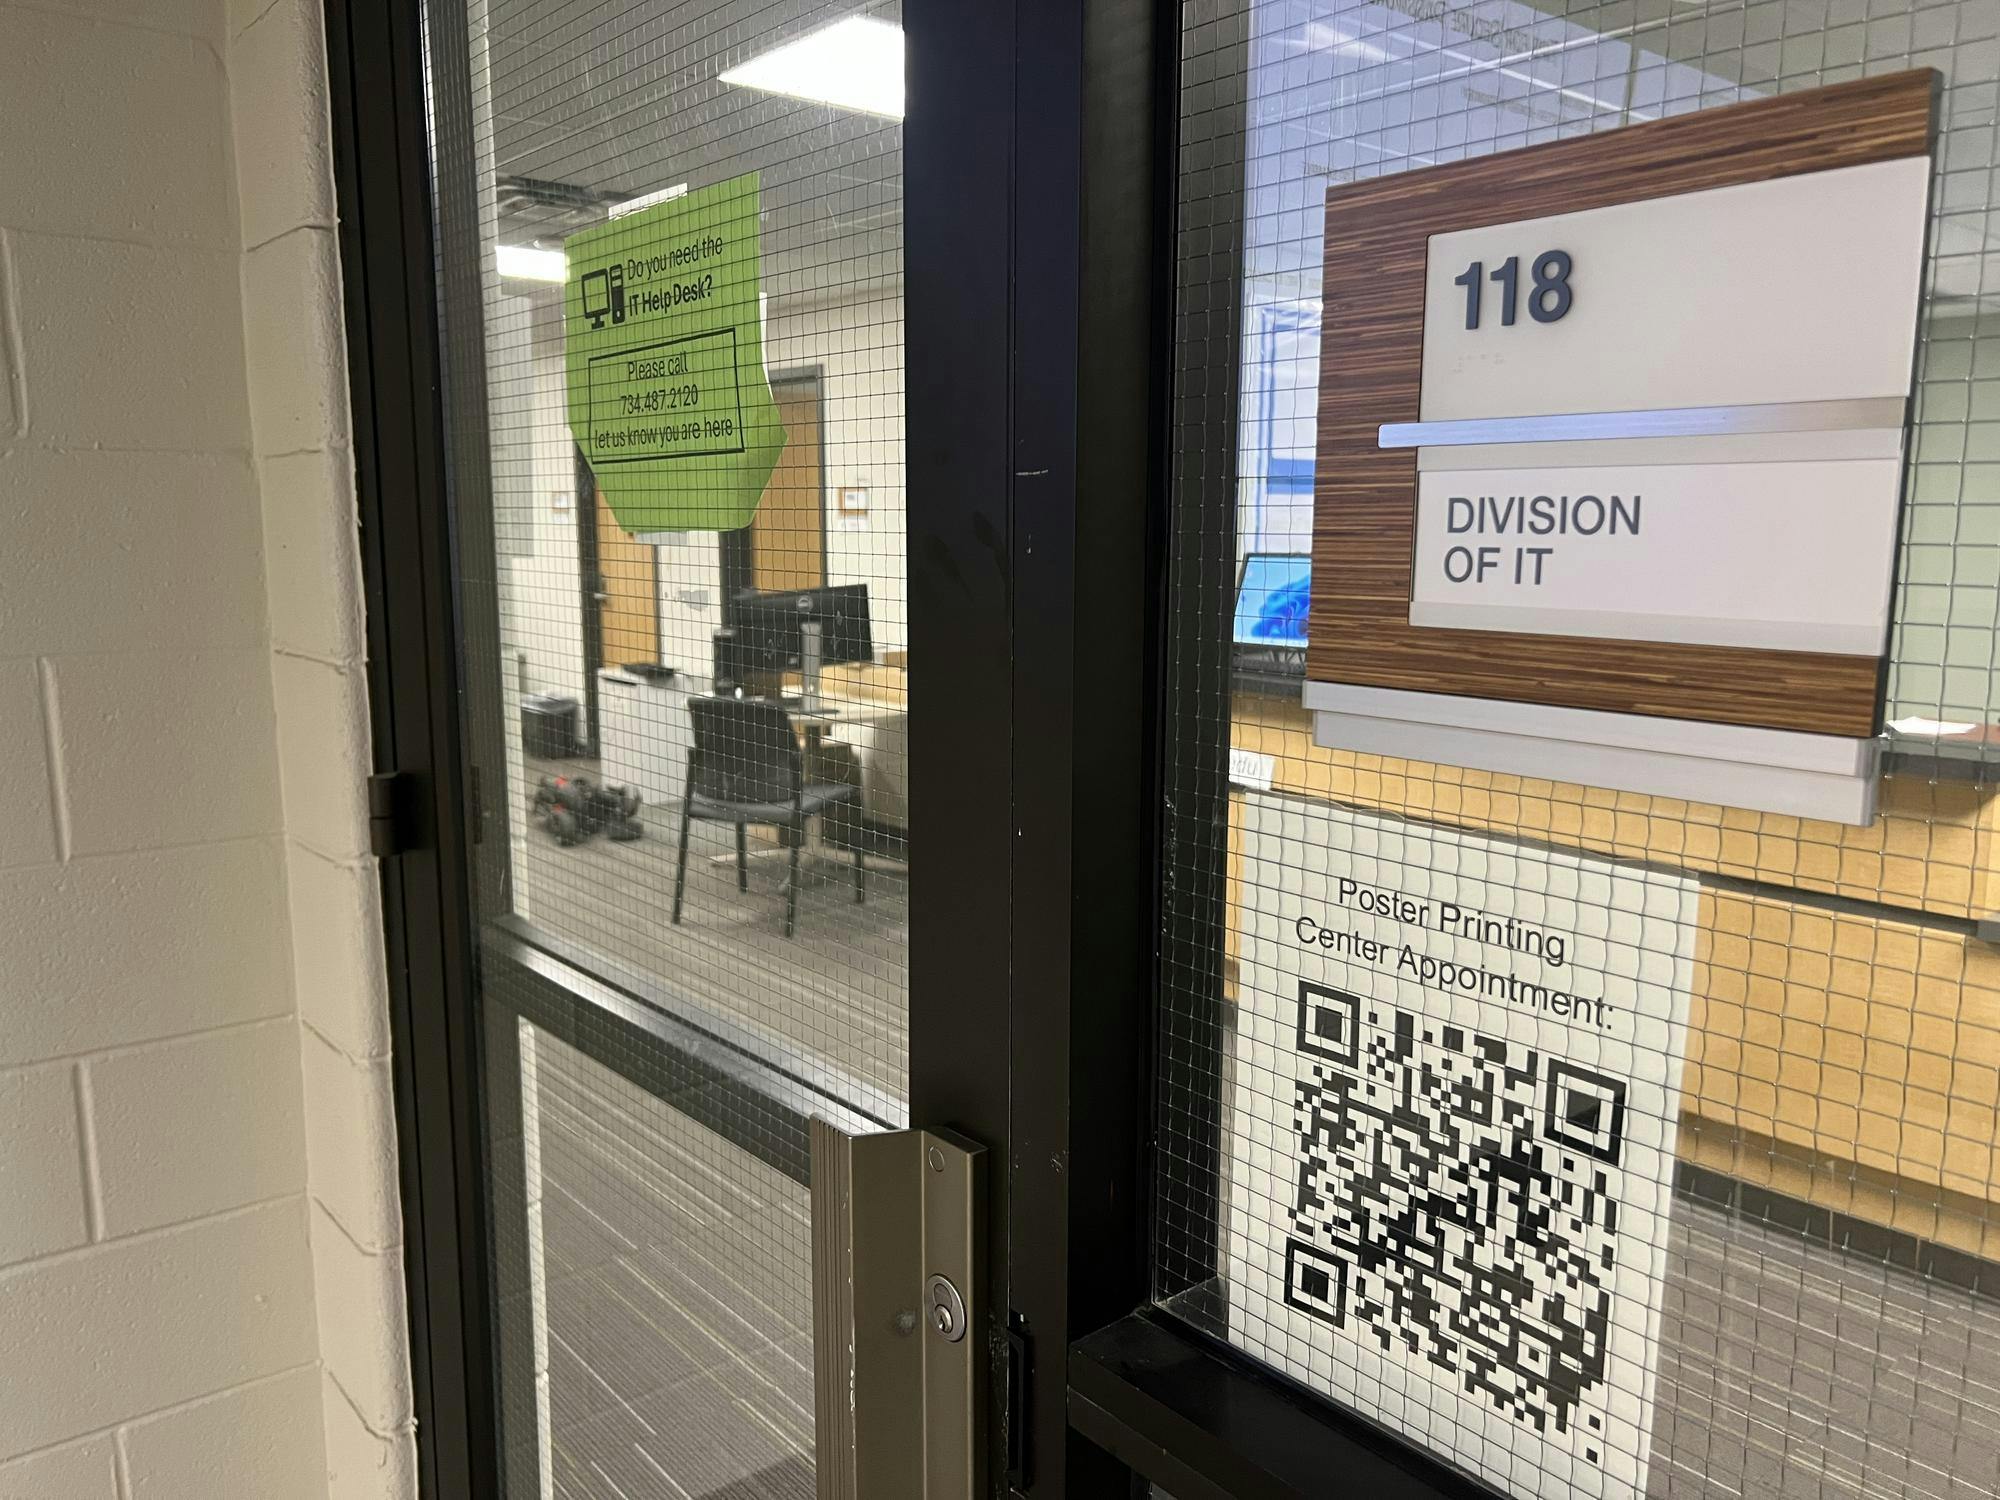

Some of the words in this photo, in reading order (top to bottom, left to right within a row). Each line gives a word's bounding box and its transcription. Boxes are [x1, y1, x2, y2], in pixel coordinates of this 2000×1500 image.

[627, 259, 644, 280] Do
[646, 254, 667, 281] you
[669, 238, 699, 269] need
[702, 235, 723, 259] the
[629, 294, 640, 317] IT
[643, 288, 672, 315] Help
[673, 274, 712, 306] Desk?
[1454, 249, 1573, 330] 118
[628, 359, 665, 381] Please
[668, 350, 689, 376] call
[620, 383, 699, 416] 734.487.2120
[595, 430, 610, 449] let
[612, 431, 626, 448] us
[628, 426, 657, 446] know
[660, 424, 679, 448] you
[681, 422, 701, 440] are
[704, 416, 733, 438] here
[1447, 494, 1641, 535] DIVISION
[1443, 546, 1500, 584] OF
[1514, 547, 1554, 586] IT
[1338, 877, 1430, 928] Poster
[1439, 902, 1565, 968] Printing
[1295, 916, 1389, 964] Center
[1396, 944, 1614, 1030] Appointment:
